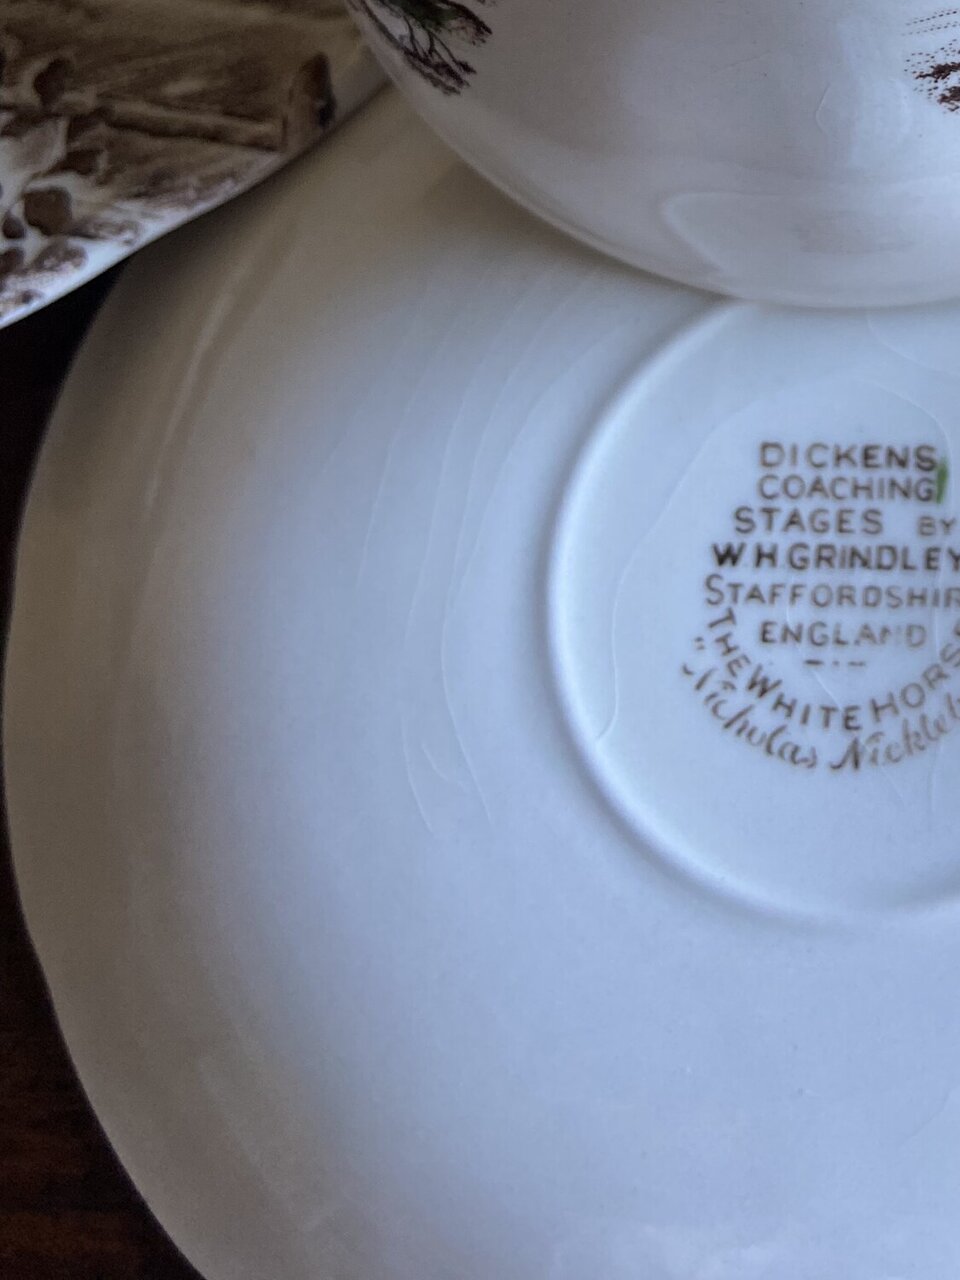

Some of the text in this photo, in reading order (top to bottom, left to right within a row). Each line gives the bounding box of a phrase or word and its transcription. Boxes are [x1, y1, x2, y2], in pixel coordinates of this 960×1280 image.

[759, 442, 939, 472] DICKENS
[757, 474, 936, 502] COACHING
[734, 506, 957, 537] STAGES BY
[760, 621, 928, 648] ENGLAND
